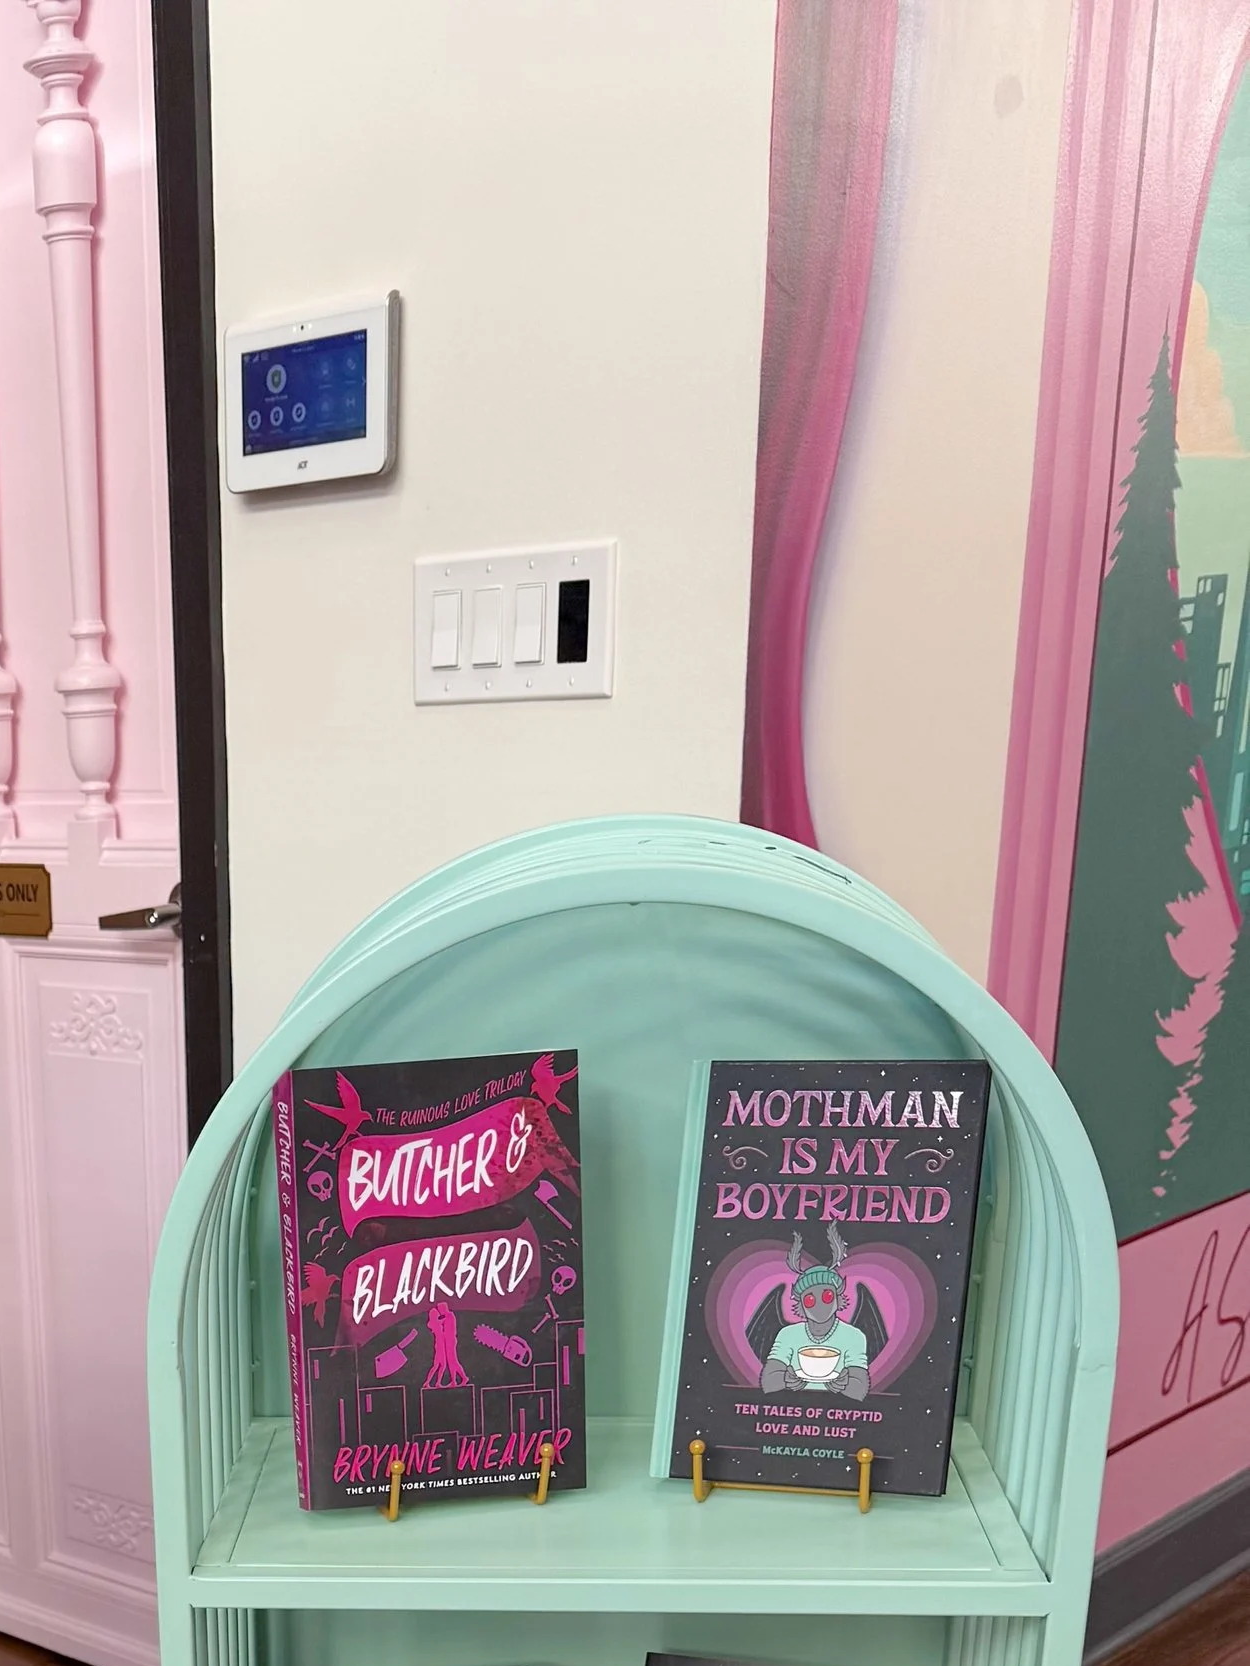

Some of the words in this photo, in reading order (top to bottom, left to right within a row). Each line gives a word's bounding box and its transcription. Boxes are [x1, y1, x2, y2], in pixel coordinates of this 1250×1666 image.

[6, 883, 38, 902] ONLY
[376, 1107, 396, 1126] THE
[400, 1101, 450, 1127] RUINOUS
[454, 1088, 481, 1114] LOVE
[484, 1069, 527, 1101] TRILOGY
[721, 1089, 964, 1129] MOTHMAN
[277, 1101, 291, 1185] BUTCHER
[347, 1129, 498, 1212] BUTCHER
[506, 1105, 533, 1173] &
[778, 1137, 818, 1175] IS
[826, 1137, 900, 1176] MY
[712, 1182, 952, 1224] BOYFRIEND
[283, 1213, 295, 1315] BLACKBIRD
[352, 1237, 534, 1325] BLACKBIRD
[735, 1403, 760, 1415] TEN
[762, 1404, 803, 1418] TALES
[805, 1406, 824, 1419] OF
[826, 1408, 883, 1423] CRYPTID
[755, 1421, 790, 1435] LOVE
[791, 1423, 821, 1437] AND
[824, 1425, 857, 1439] LUST
[333, 1438, 445, 1484] BRYNNE
[762, 1444, 810, 1457] McKAYLA
[812, 1447, 845, 1459] COYLE
[346, 1487, 363, 1495] THE
[366, 1486, 376, 1494] #1
[378, 1485, 390, 1493] NE
[402, 1482, 426, 1491] YORK
[428, 1479, 454, 1489] TIMES
[457, 1474, 516, 1486] BESTSELLING
[518, 1471, 557, 1481] AUTHR
